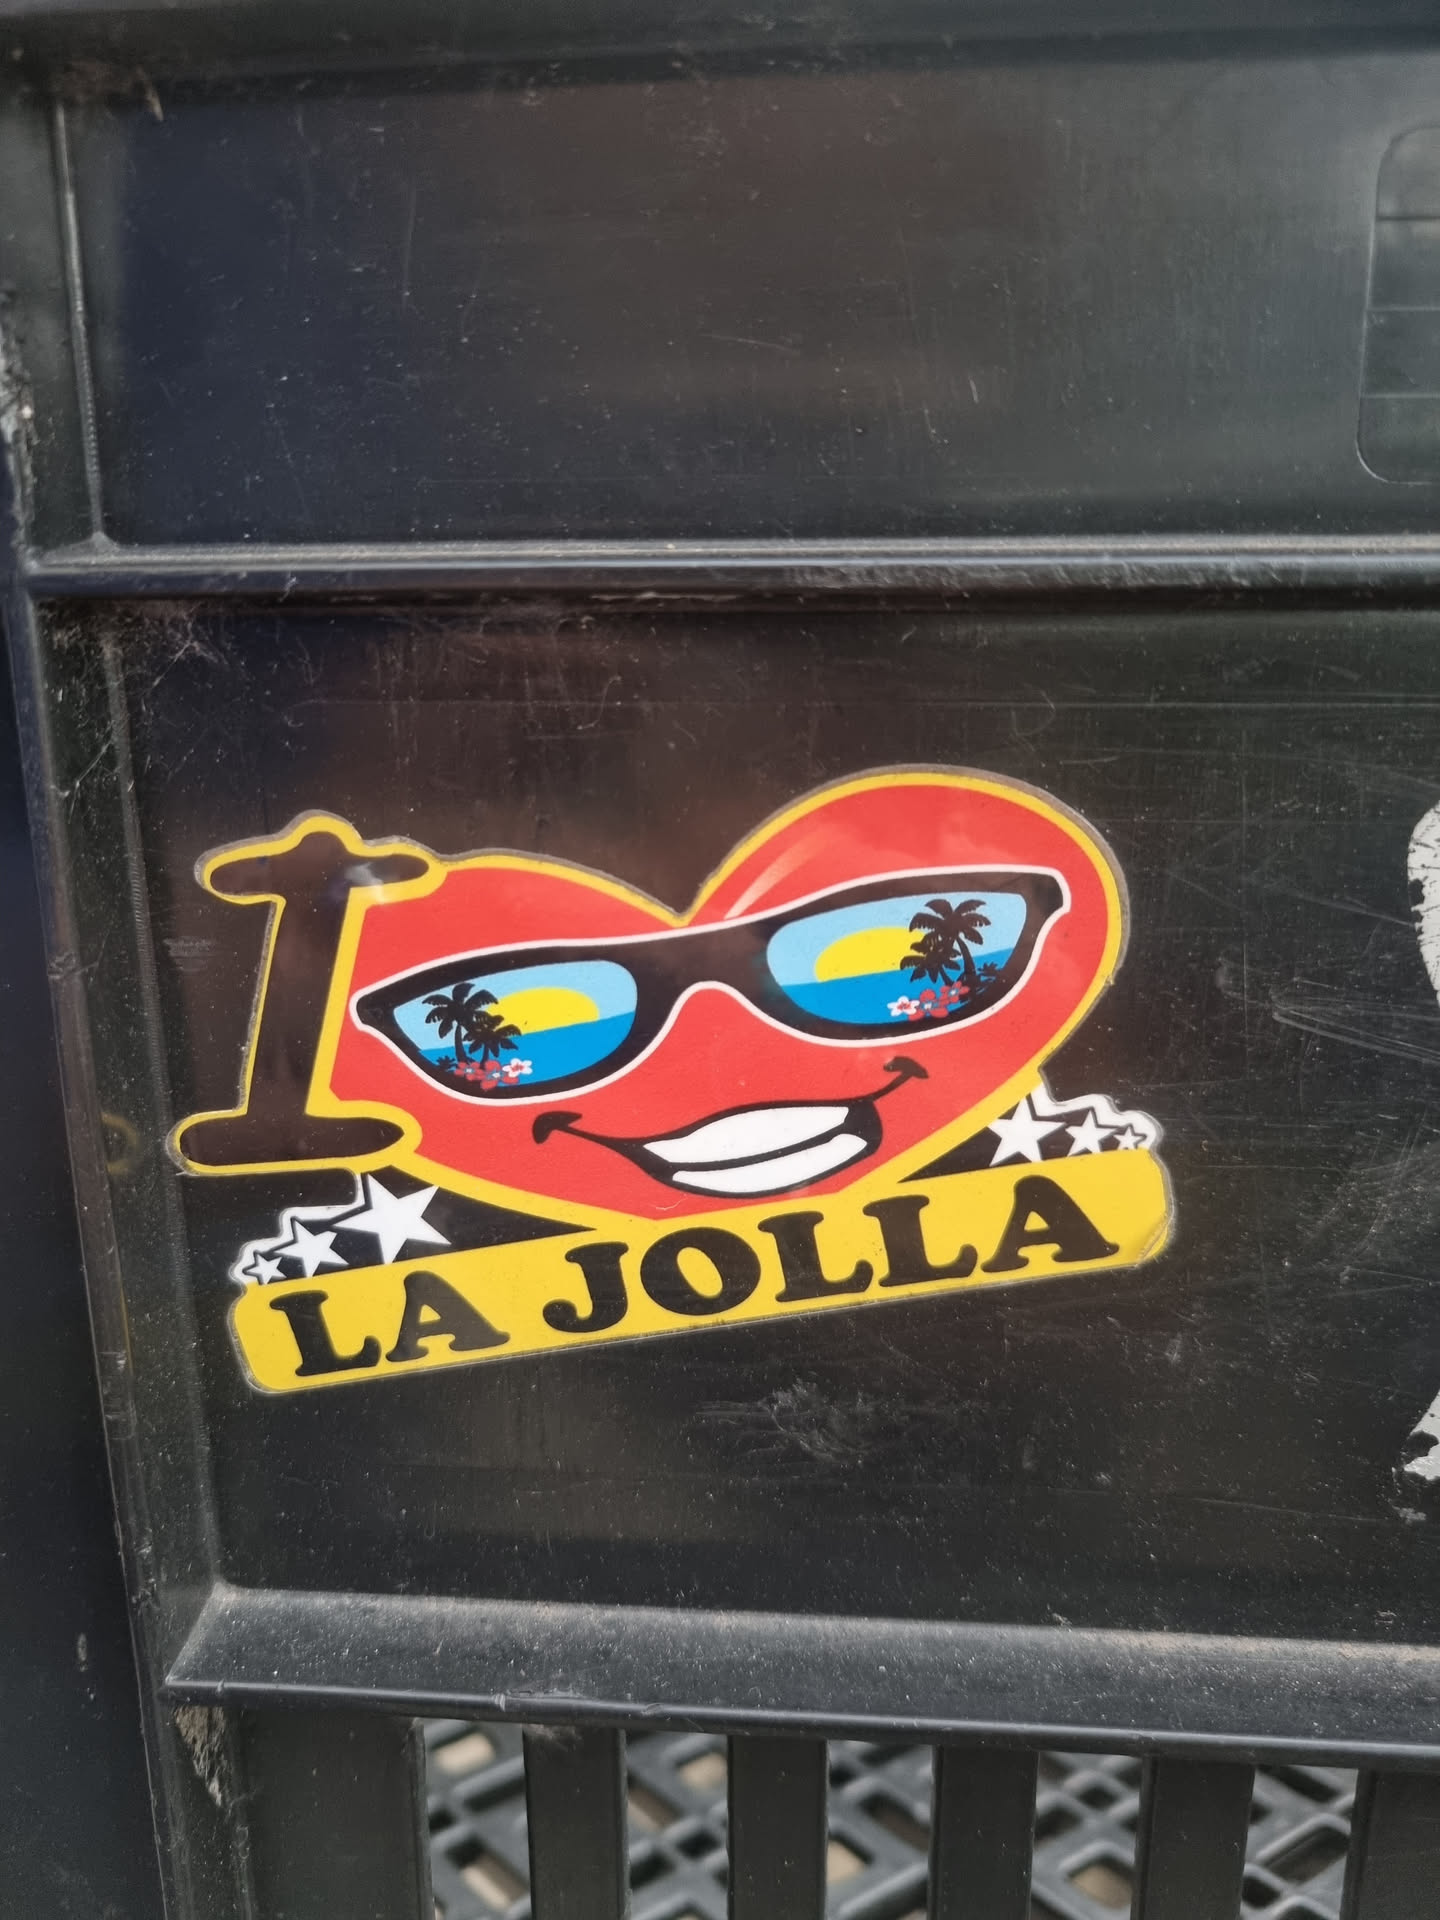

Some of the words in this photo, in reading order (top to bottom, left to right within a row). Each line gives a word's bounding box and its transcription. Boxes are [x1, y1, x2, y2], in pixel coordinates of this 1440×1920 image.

[179, 830, 430, 1167] I
[269, 1269, 510, 1377] LA
[542, 1175, 1120, 1333] JOLLA
